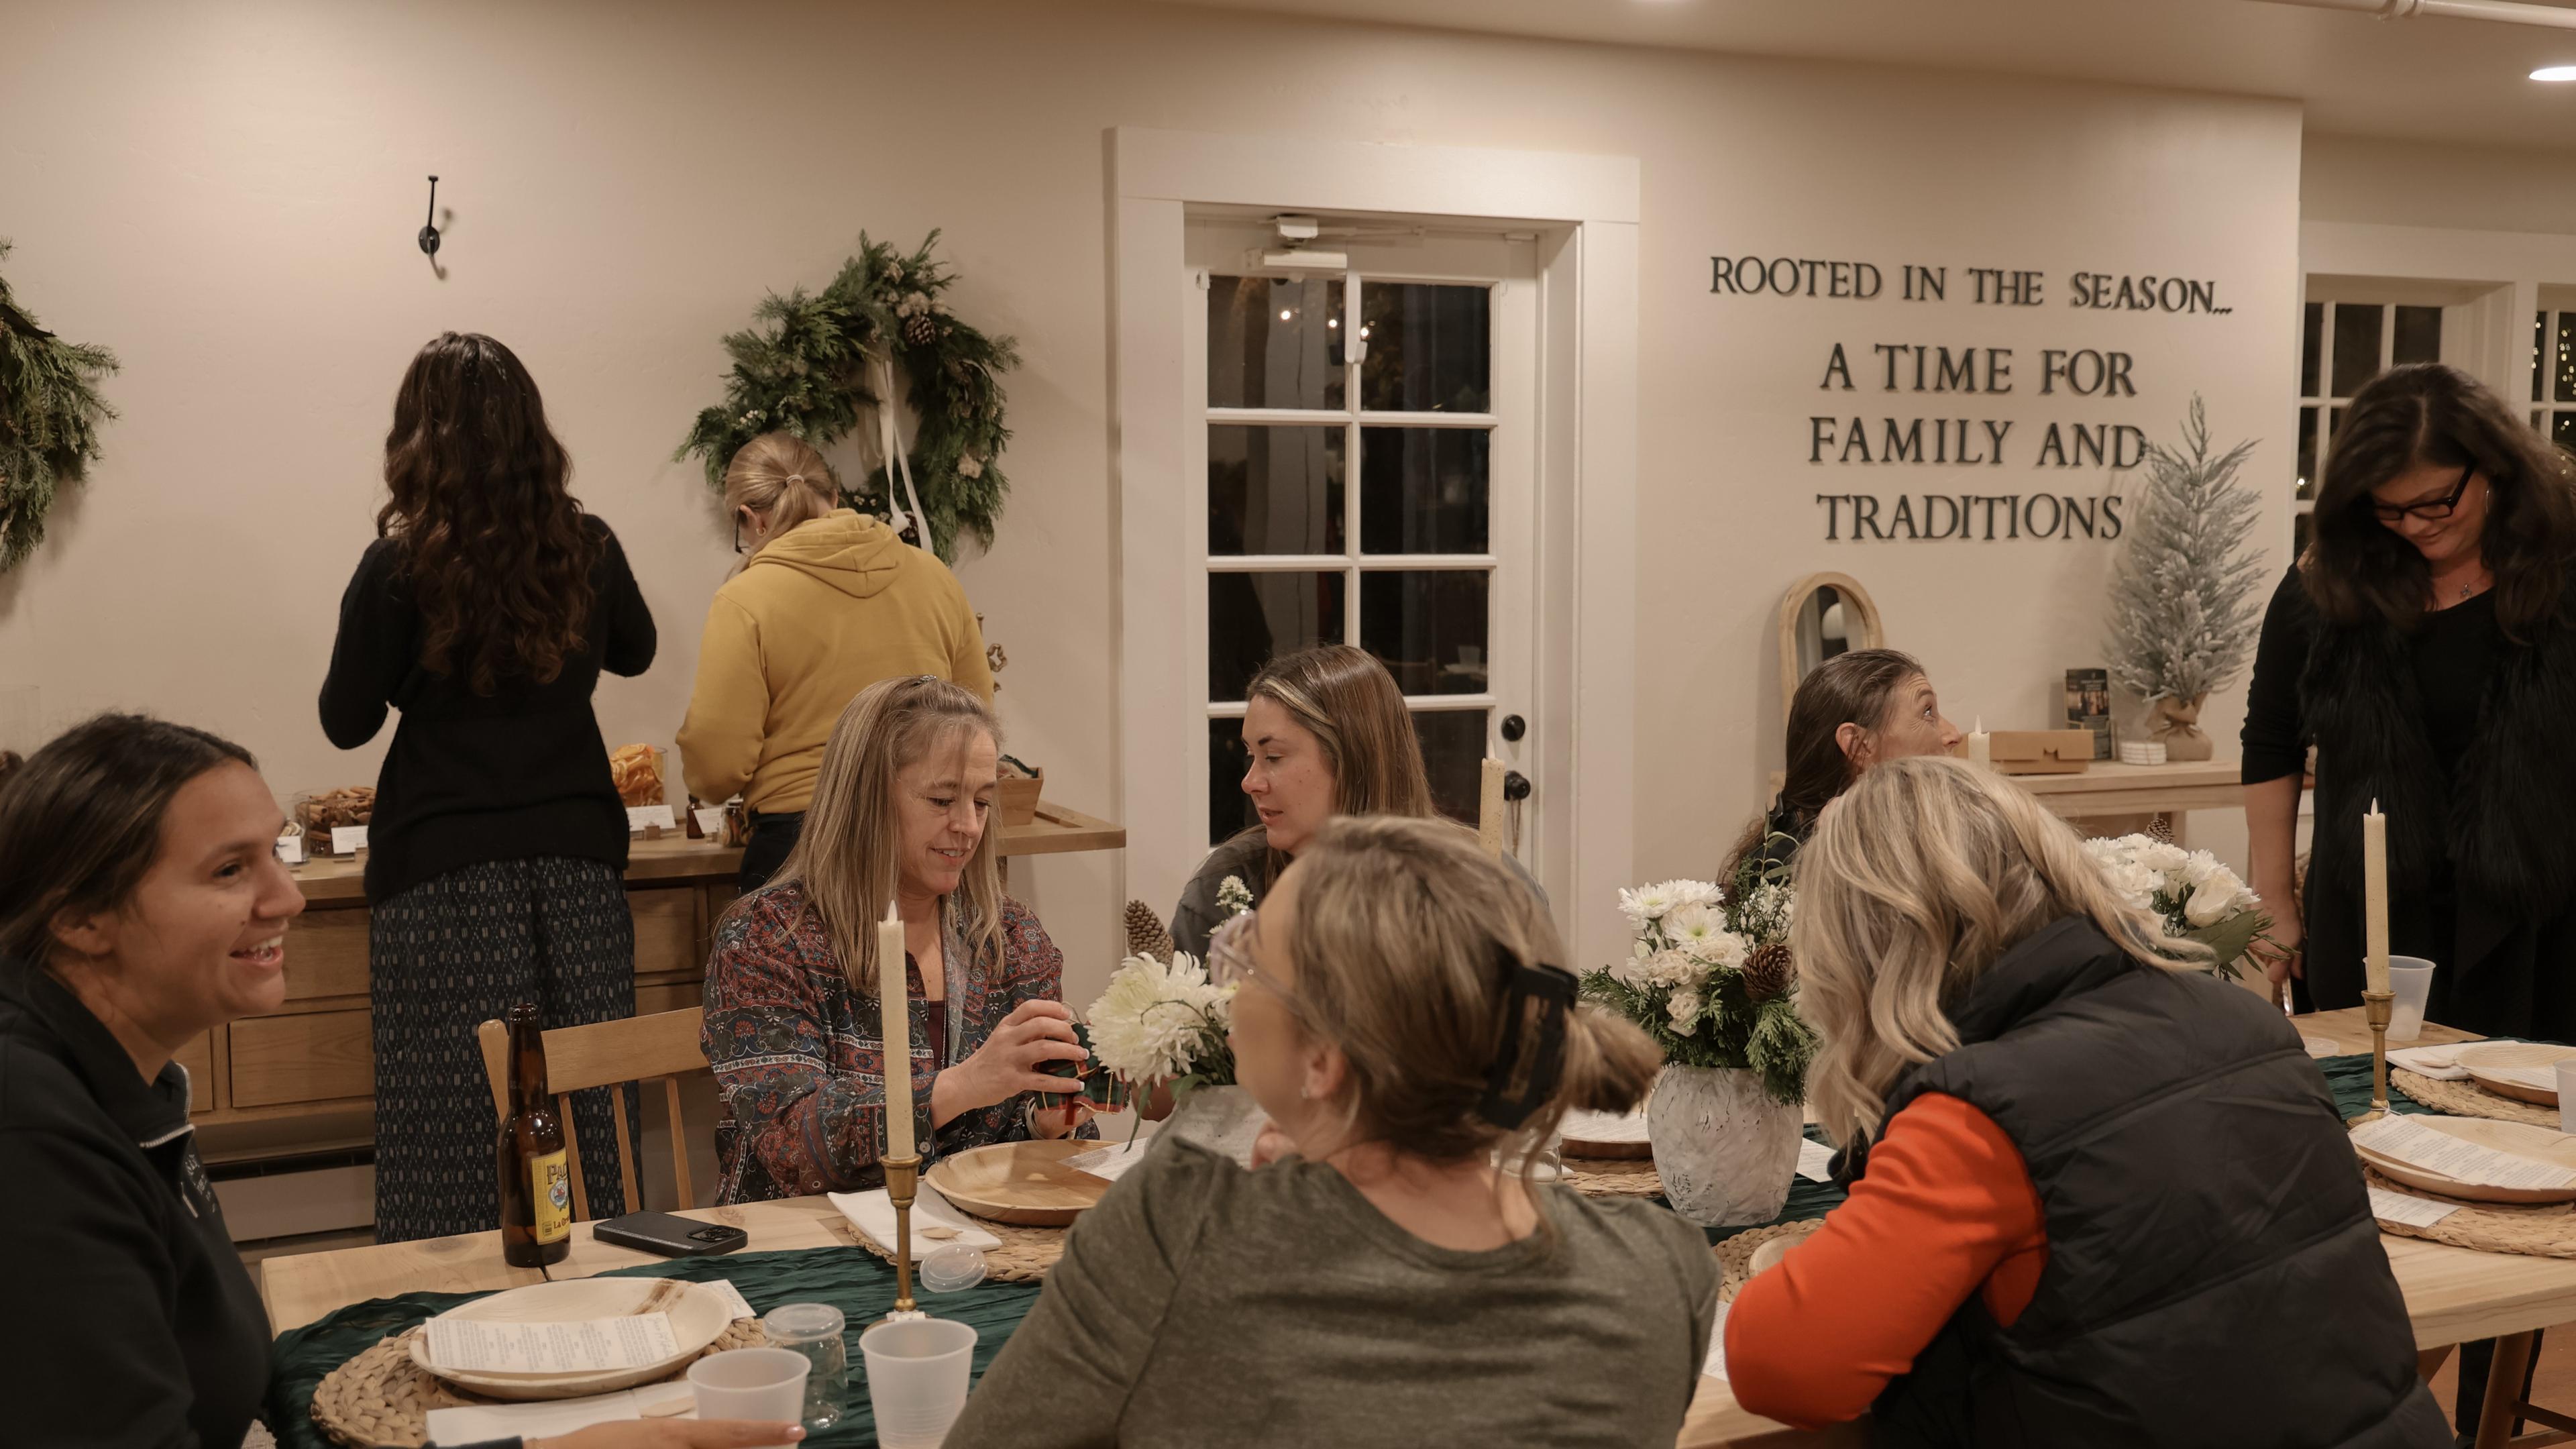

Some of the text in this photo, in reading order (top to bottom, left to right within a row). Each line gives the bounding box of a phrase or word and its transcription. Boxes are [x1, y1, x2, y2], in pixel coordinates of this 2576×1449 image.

[1710, 256, 2233, 314] ROOTED IN THE SEASON...
[1820, 343, 2137, 396] A TIME FOR
[1809, 417, 2145, 468] FAMILY AND
[1816, 494, 2123, 540] TRADITIONS
